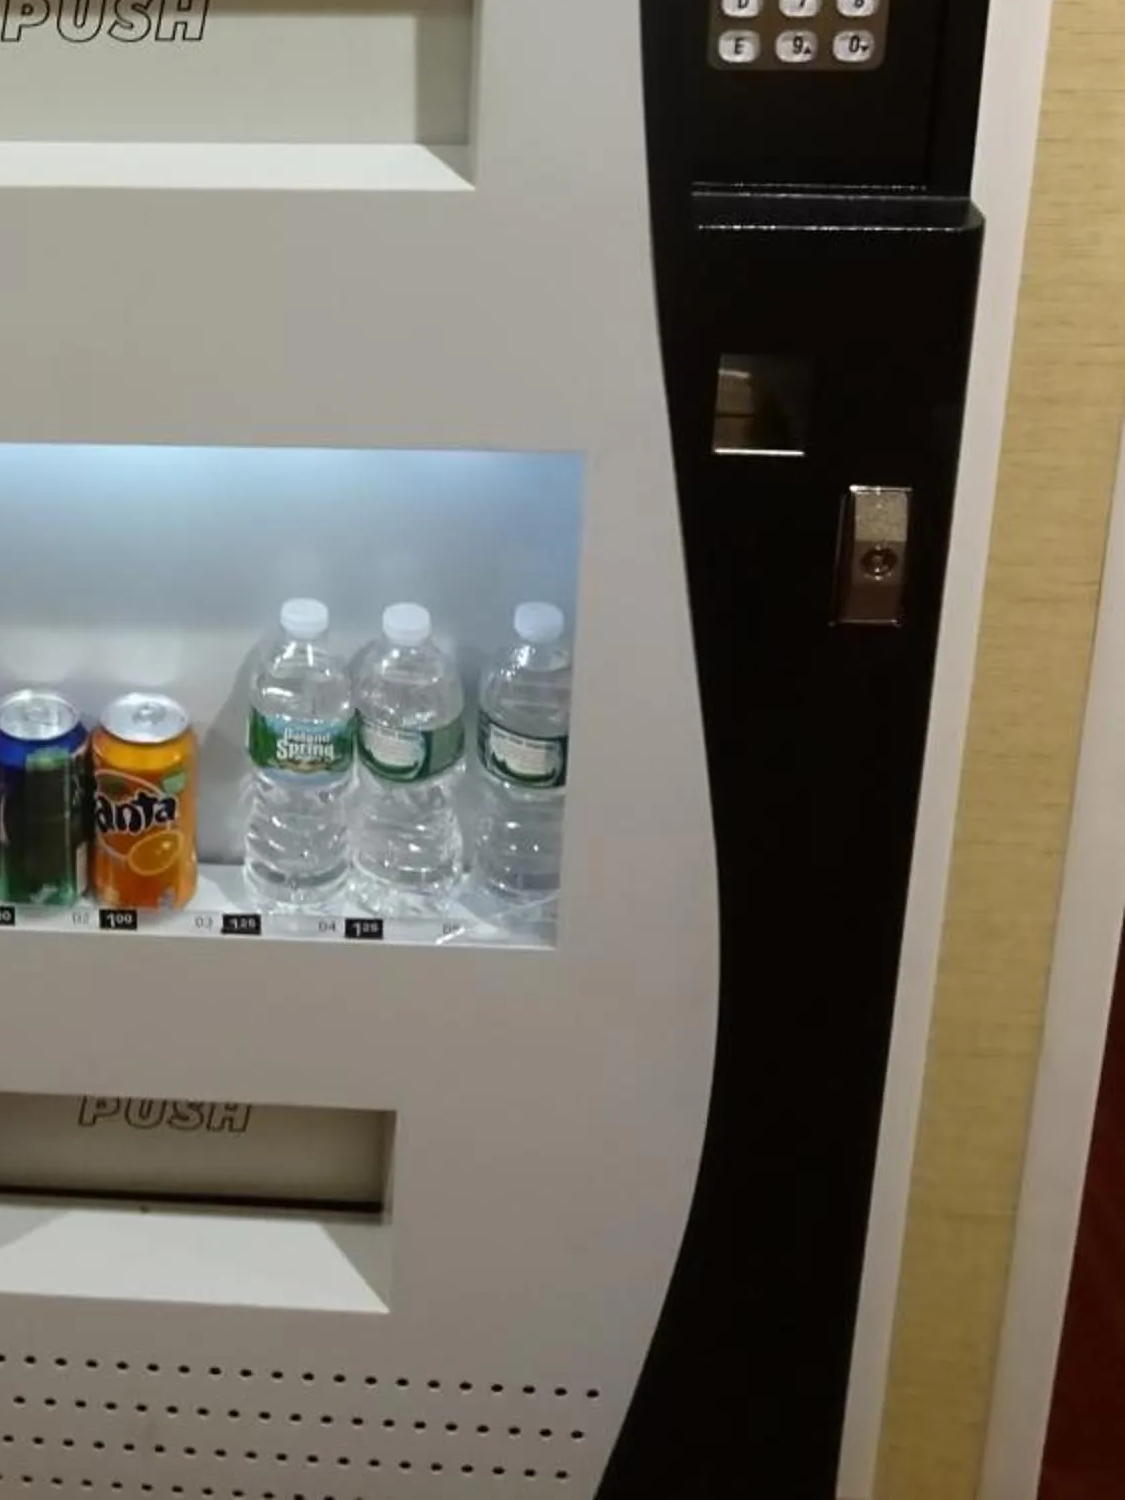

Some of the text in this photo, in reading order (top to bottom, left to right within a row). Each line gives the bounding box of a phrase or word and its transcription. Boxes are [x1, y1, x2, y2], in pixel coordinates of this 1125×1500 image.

[734, 37, 745, 55] E
[792, 35, 804, 54] 9
[848, 34, 860, 53] 0
[276, 739, 335, 761] Spring
[95, 790, 179, 836] anta
[77, 1095, 252, 1133] PUSH
